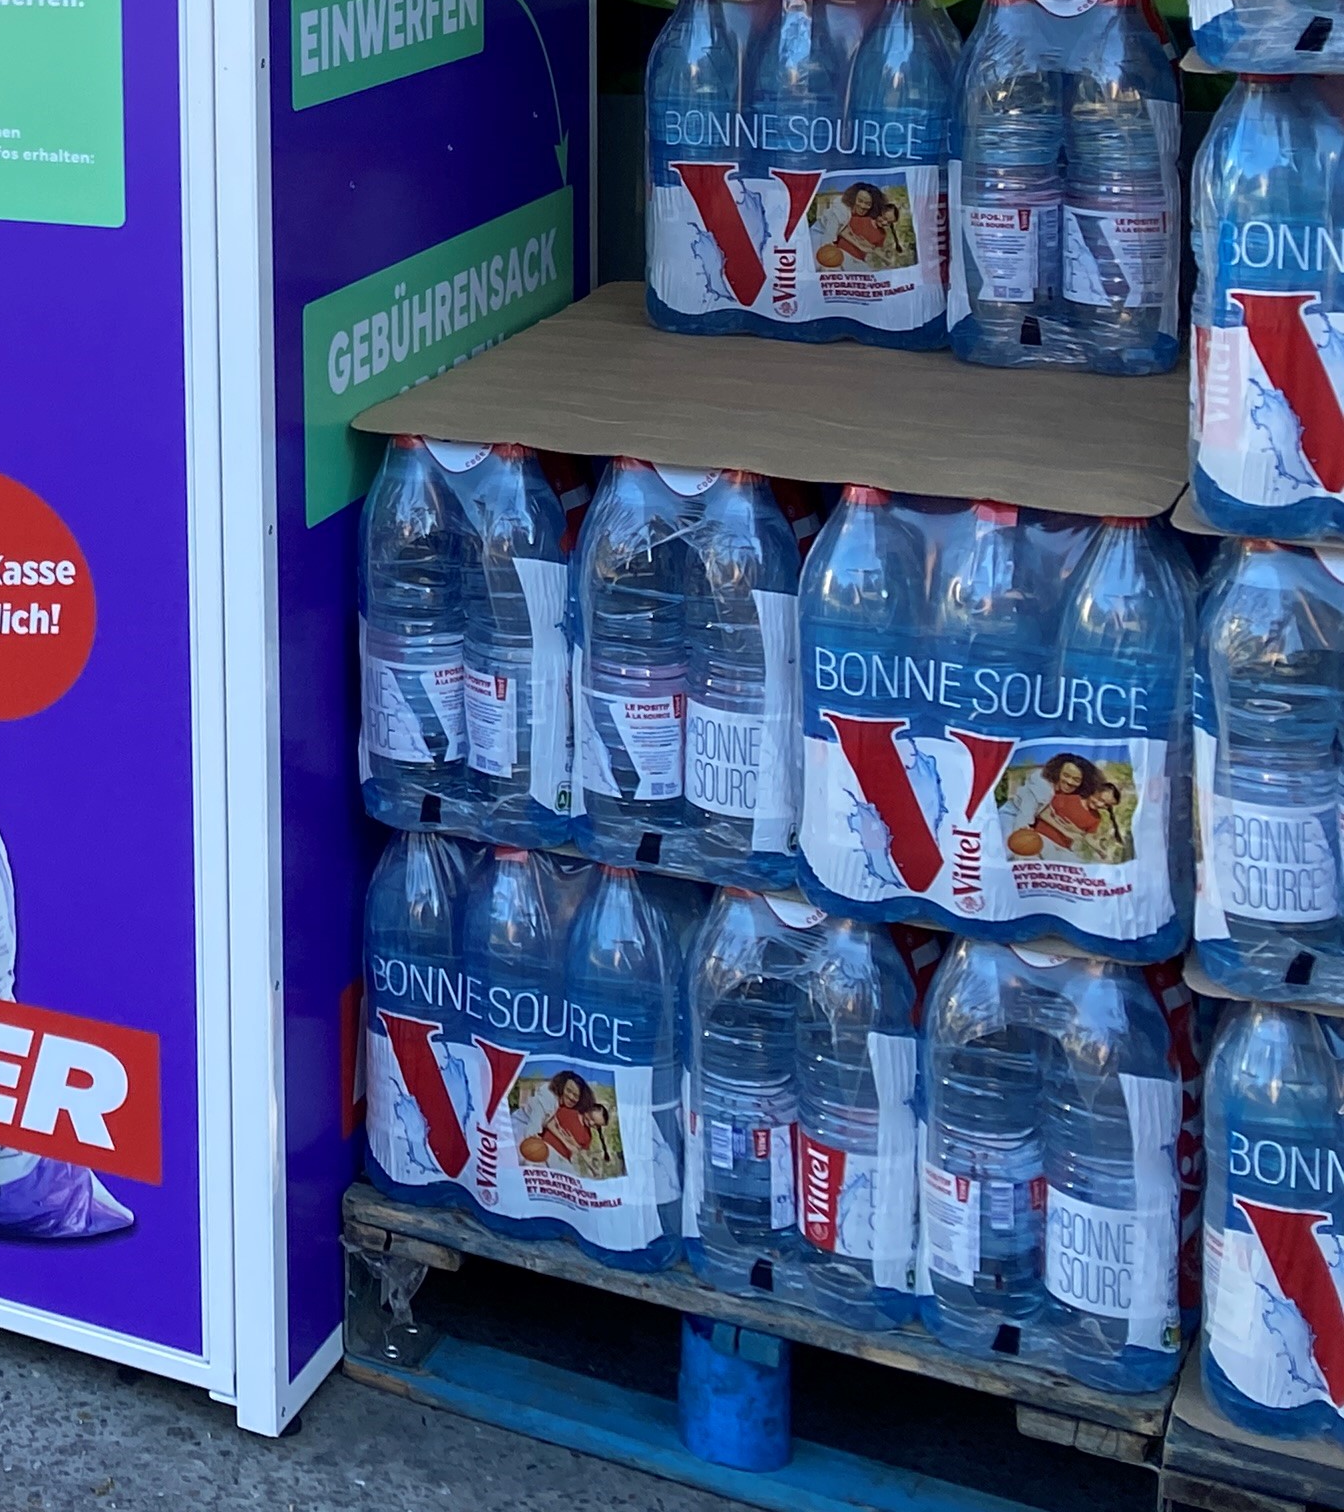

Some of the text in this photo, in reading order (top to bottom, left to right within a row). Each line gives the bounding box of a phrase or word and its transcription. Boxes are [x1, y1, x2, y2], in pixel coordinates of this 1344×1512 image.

[23, 148, 95, 164] erhalten:
[665, 110, 926, 160] BONNE SOURCE
[1219, 220, 1344, 272] BONN
[773, 247, 796, 303] Vittel
[327, 226, 557, 396] GEBÜHRENSACK
[625, 703, 636, 711] LE
[815, 647, 1148, 731] BONNE SOURCE
[695, 716, 760, 766] BONNE
[695, 759, 757, 809] SOURC
[953, 824, 981, 896] Vittel
[1232, 815, 1313, 864] BONNE
[1232, 862, 1322, 912] SOURCE
[372, 955, 633, 1062] BONNE SOURCE
[476, 1124, 498, 1190] Vittel
[807, 1147, 830, 1224] Vittel
[1061, 1206, 1135, 1266] BONNE
[1059, 1251, 1132, 1310] SOURC
